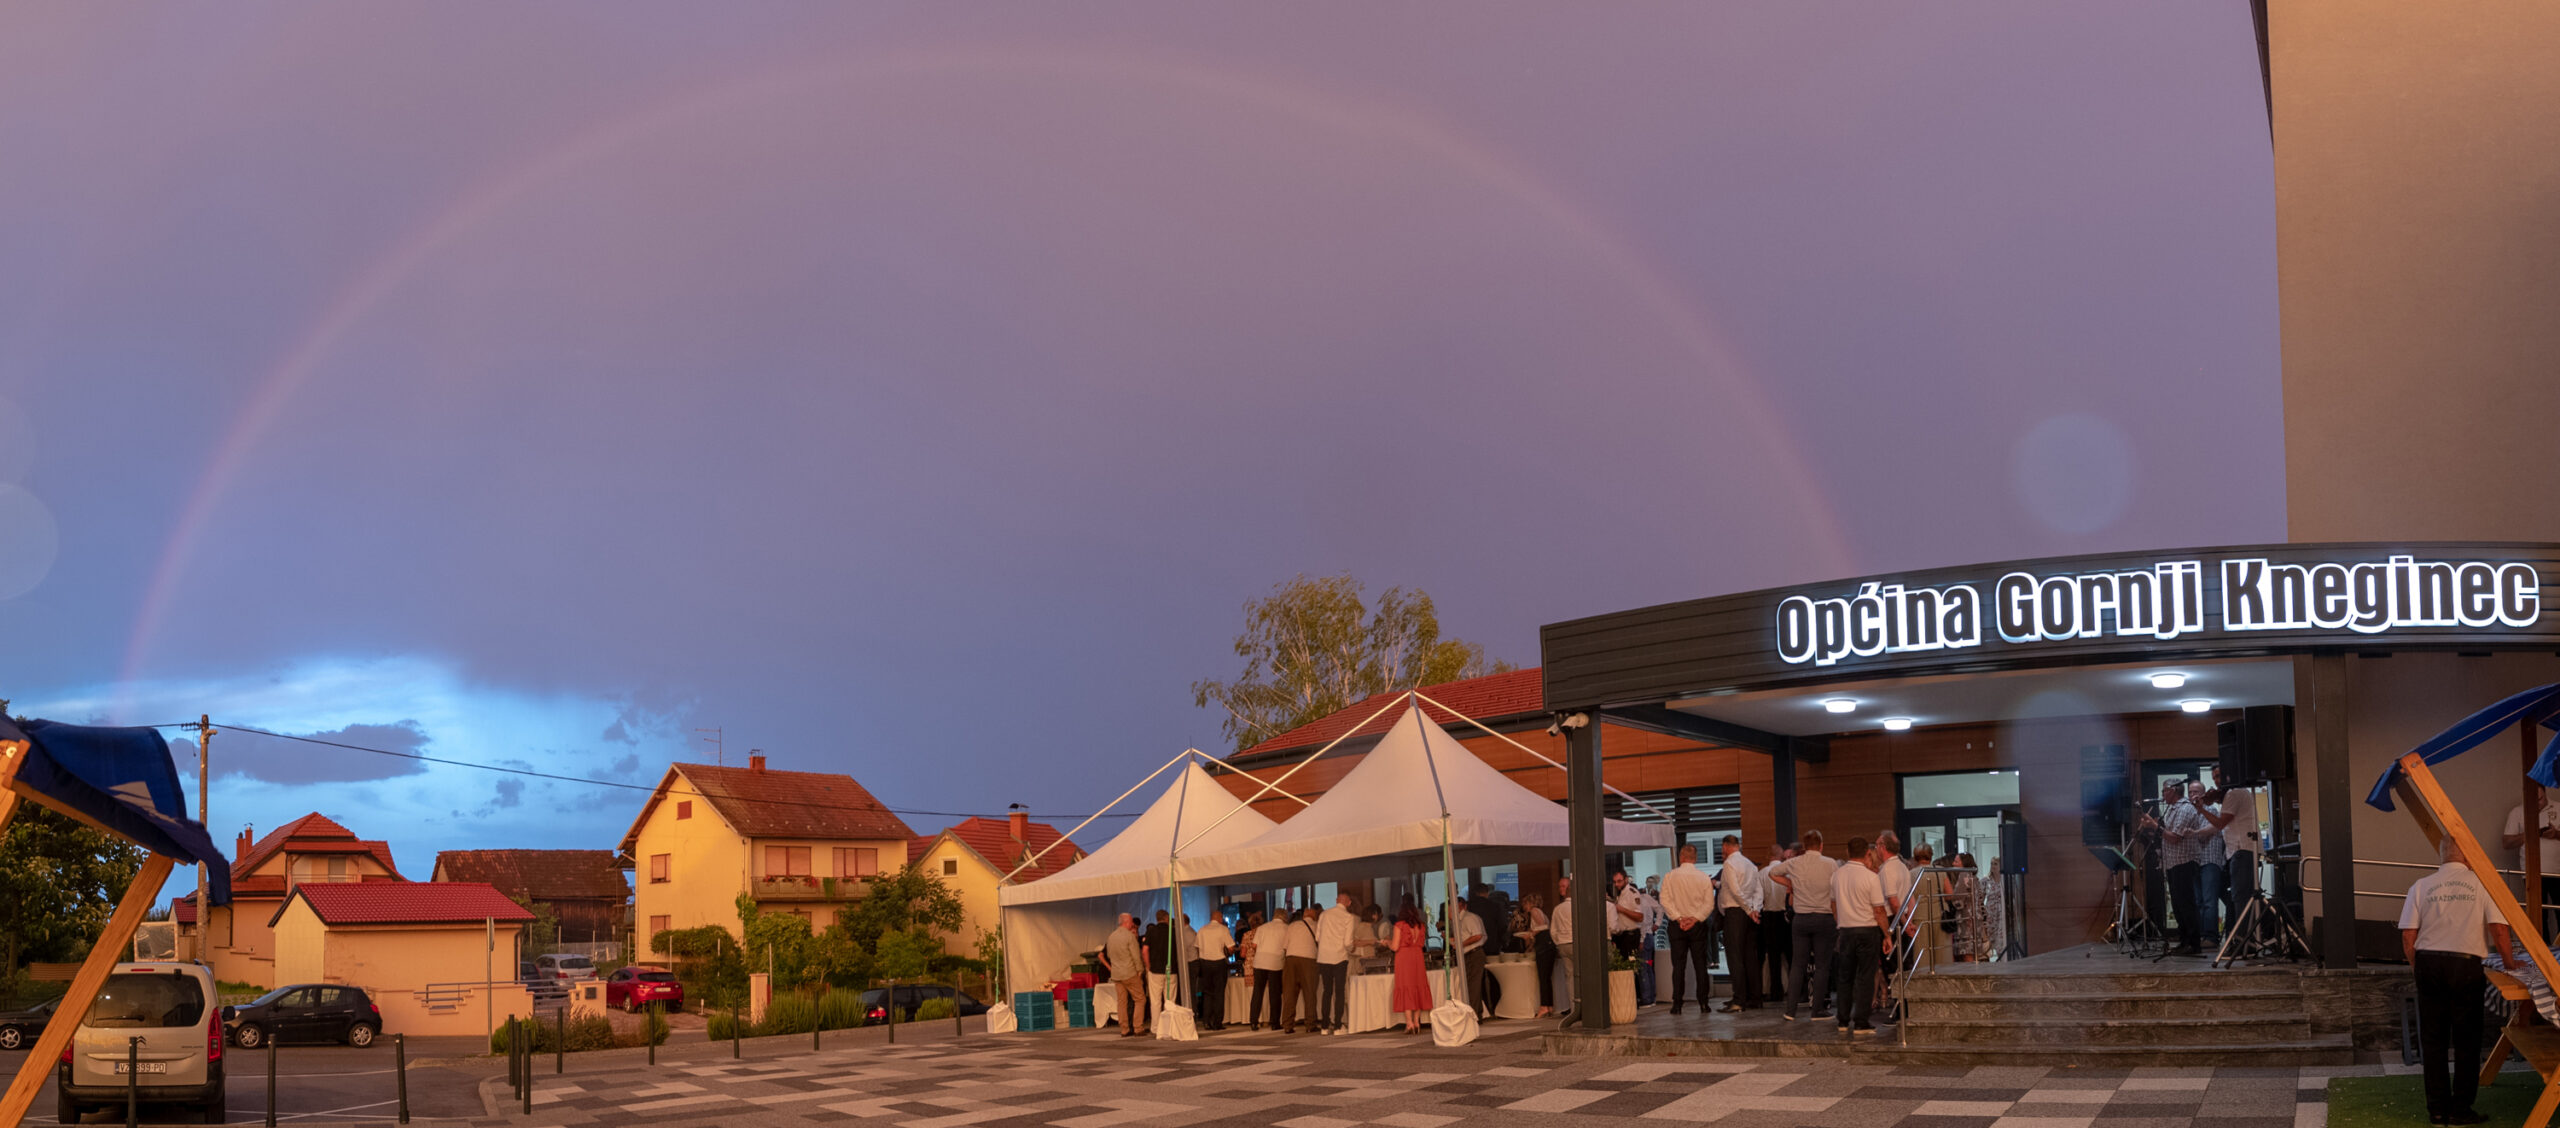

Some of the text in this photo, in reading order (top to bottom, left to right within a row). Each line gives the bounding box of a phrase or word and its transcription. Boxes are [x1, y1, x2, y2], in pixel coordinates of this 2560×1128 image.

[1777, 555, 2540, 666] Općina Gornji Kneginec
